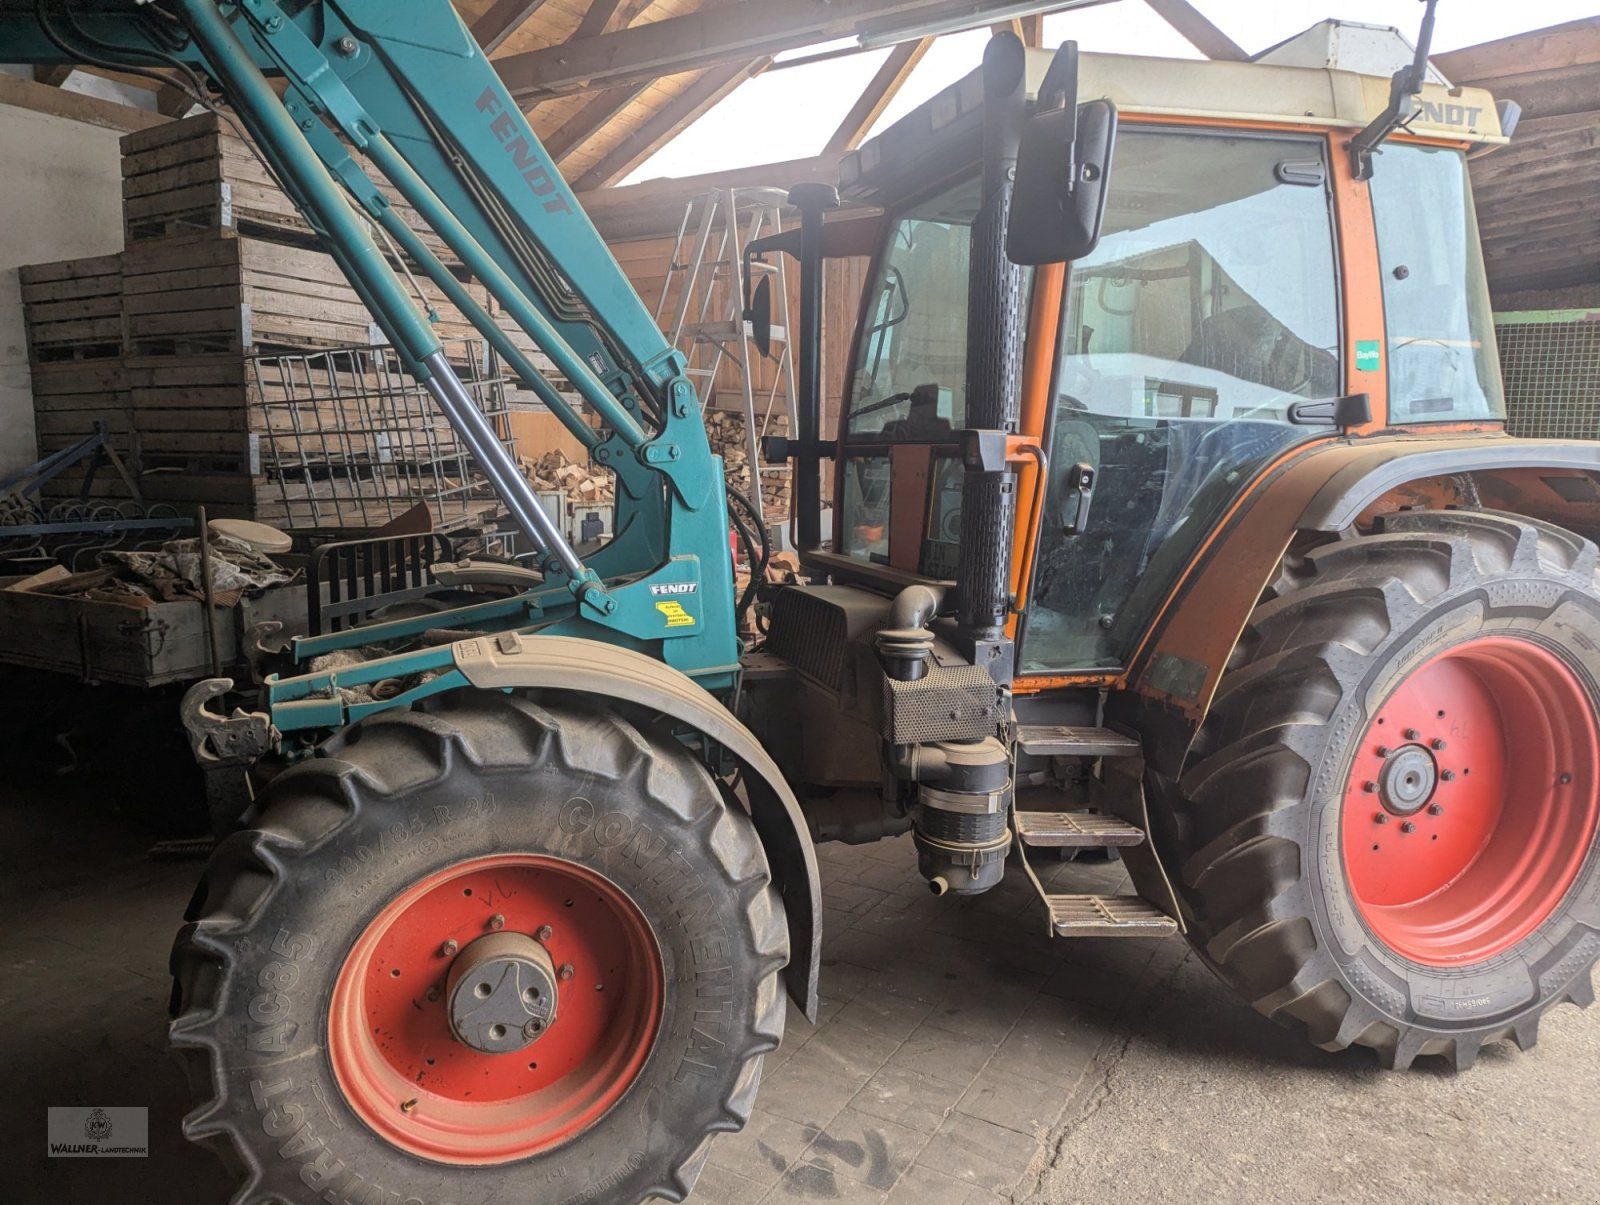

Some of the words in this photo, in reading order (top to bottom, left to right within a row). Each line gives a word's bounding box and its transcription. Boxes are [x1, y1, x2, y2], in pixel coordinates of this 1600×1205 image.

[475, 85, 573, 215] FENDT
[651, 583, 697, 595] FENDT
[246, 928, 313, 1052] AC85
[558, 796, 733, 1083] CONTINENTAL
